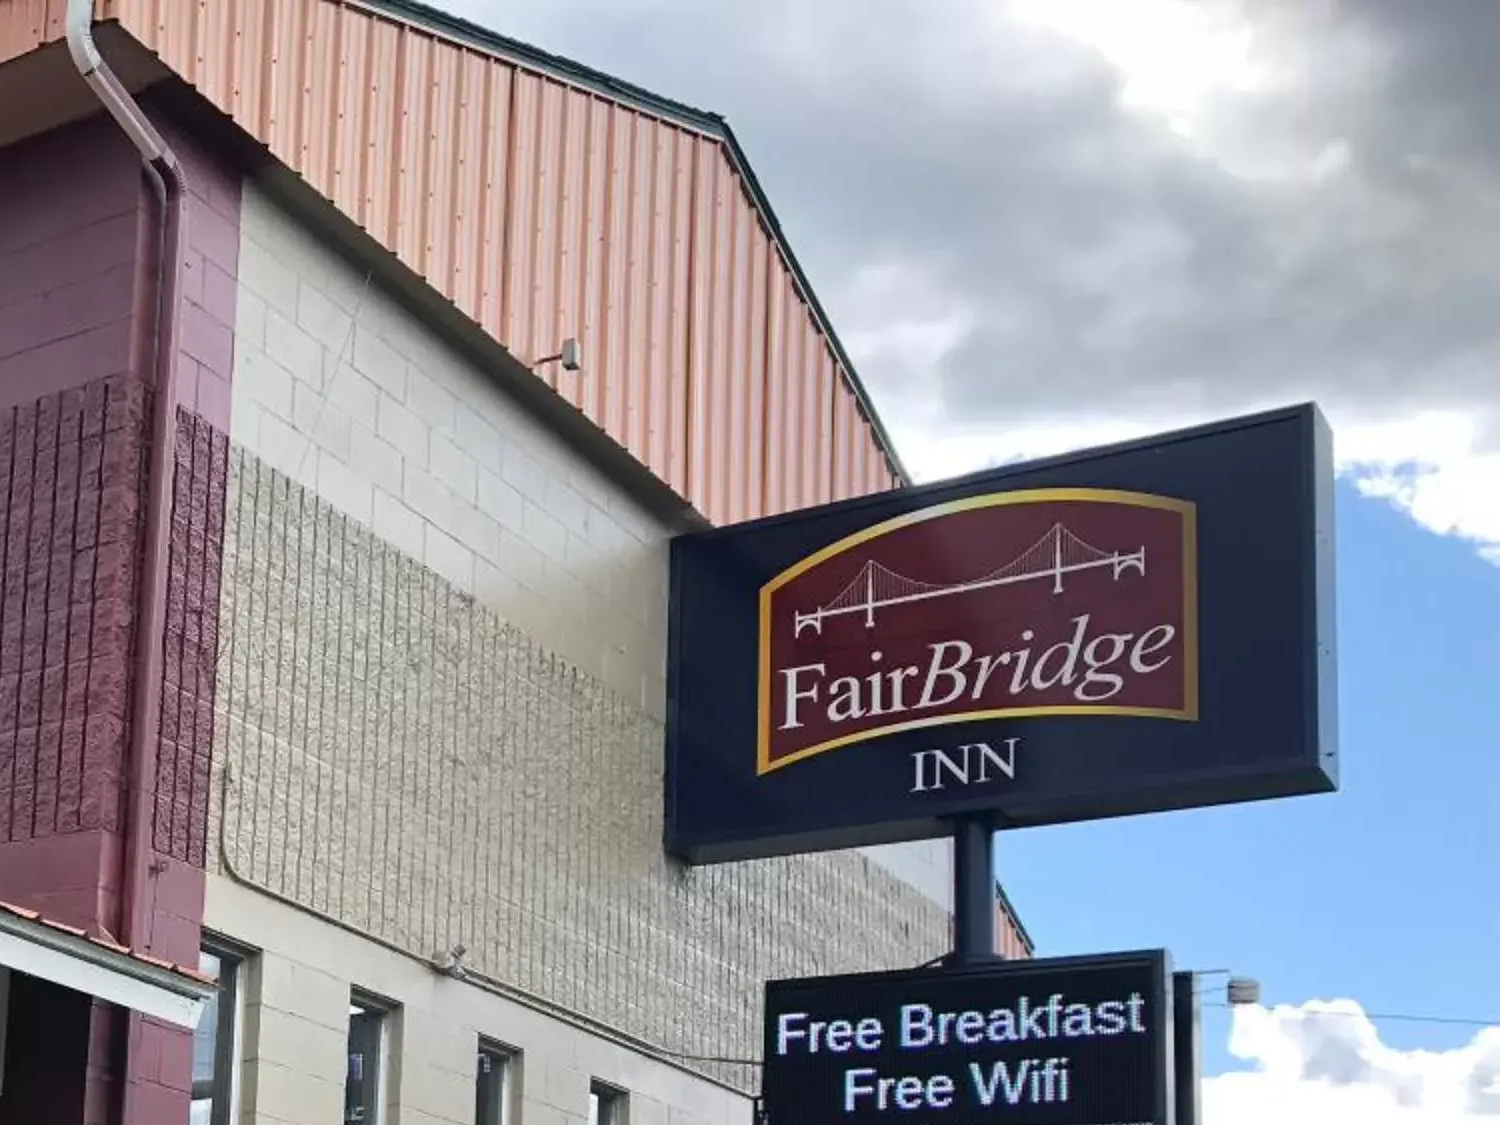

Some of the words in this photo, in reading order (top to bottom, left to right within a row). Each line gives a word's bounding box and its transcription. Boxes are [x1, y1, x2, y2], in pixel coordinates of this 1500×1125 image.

[778, 614, 1175, 731] FairBridge
[910, 738, 1021, 792] INN
[775, 1011, 884, 1056] Free
[900, 991, 1147, 1049] Breakfast
[843, 1068, 955, 1112] Free
[968, 1056, 1070, 1106] Wifi
